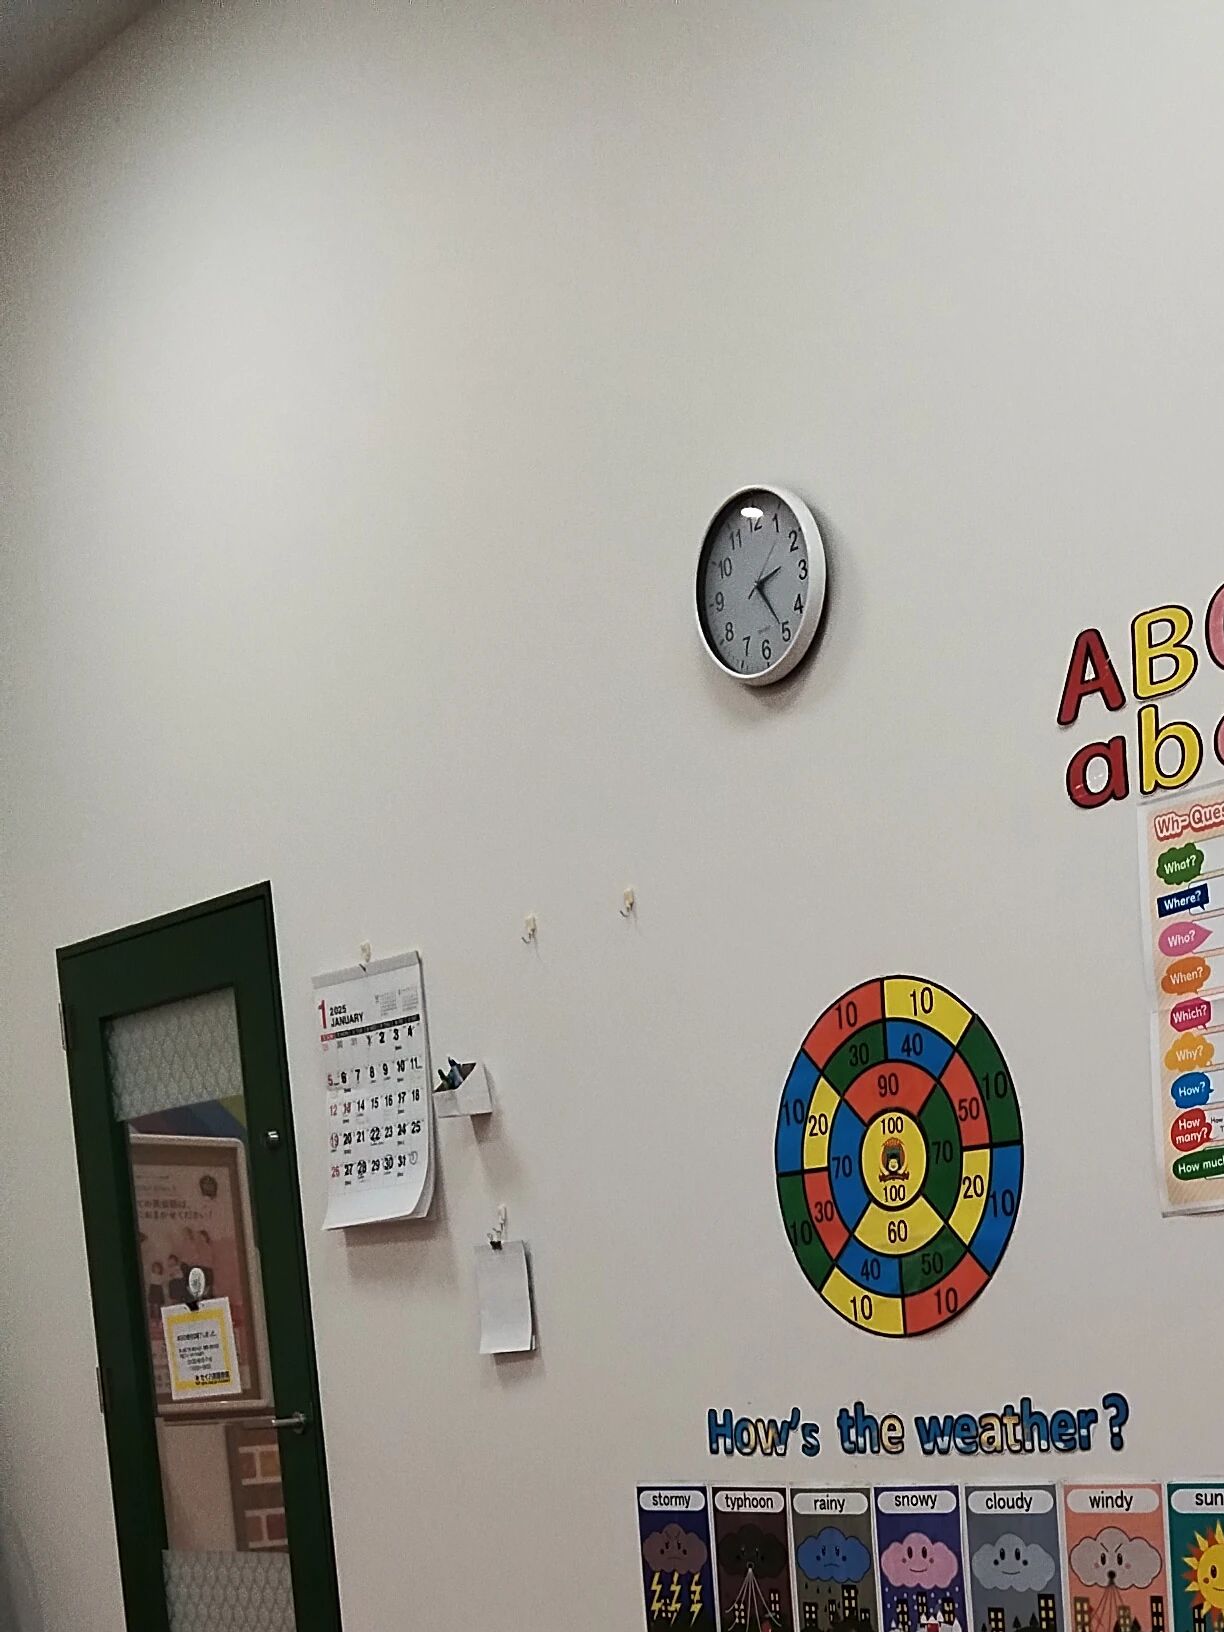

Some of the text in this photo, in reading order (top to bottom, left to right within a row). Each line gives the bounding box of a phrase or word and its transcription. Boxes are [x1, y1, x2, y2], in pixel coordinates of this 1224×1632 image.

[771, 513, 780, 533] 1
[730, 528, 742, 550] 11
[788, 530, 799, 552] 2
[719, 557, 733, 579] 10
[798, 559, 808, 580] 3
[715, 592, 725, 612] 9
[793, 594, 804, 614] 4
[725, 621, 735, 641] 8
[781, 621, 791, 642] 5
[742, 636, 751, 656] 7
[761, 639, 771, 660] 6
[1164, 855, 1197, 875] What?
[1164, 891, 1202, 911] Where?
[1168, 930, 1196, 948] Who?
[1170, 967, 1204, 985] When?
[329, 1004, 347, 1017] 2025
[909, 986, 934, 1016] 10
[318, 999, 327, 1029] 1
[330, 1012, 364, 1028] JANUARY
[834, 1001, 858, 1030] 10
[1173, 1005, 1208, 1024] Which?
[849, 1042, 870, 1068] 30
[901, 1032, 924, 1057] 40
[1176, 1046, 1204, 1062] Why?
[877, 1072, 900, 1097] 90
[982, 1070, 1008, 1101] 10
[1178, 1081, 1206, 1097] How?
[783, 1099, 805, 1126] 10
[957, 1096, 981, 1123] 50
[808, 1113, 828, 1138] 20
[880, 1115, 904, 1135] 100
[1178, 1118, 1201, 1130] How
[1176, 1127, 1208, 1144] many?
[932, 1140, 954, 1165] 70
[832, 1154, 853, 1179] 70
[1178, 1162, 1200, 1174] How
[883, 1184, 906, 1203] 100
[962, 1174, 986, 1200] 20
[814, 1200, 834, 1224] 30
[990, 1188, 1015, 1217] 10
[791, 1220, 814, 1247] 10
[887, 1219, 908, 1244] 60
[860, 1256, 882, 1281] 40
[921, 1251, 944, 1277] 50
[850, 1293, 874, 1322] 10
[934, 1286, 960, 1316] 10
[707, 1406, 820, 1457] How's
[837, 1402, 905, 1455] the
[652, 1493, 691, 1509] stormy
[724, 1493, 774, 1511] typhoon
[813, 1494, 846, 1513] rainy
[894, 1493, 938, 1510] snowy
[985, 1491, 1033, 1512] cloudy
[1088, 1490, 1134, 1512] windy
